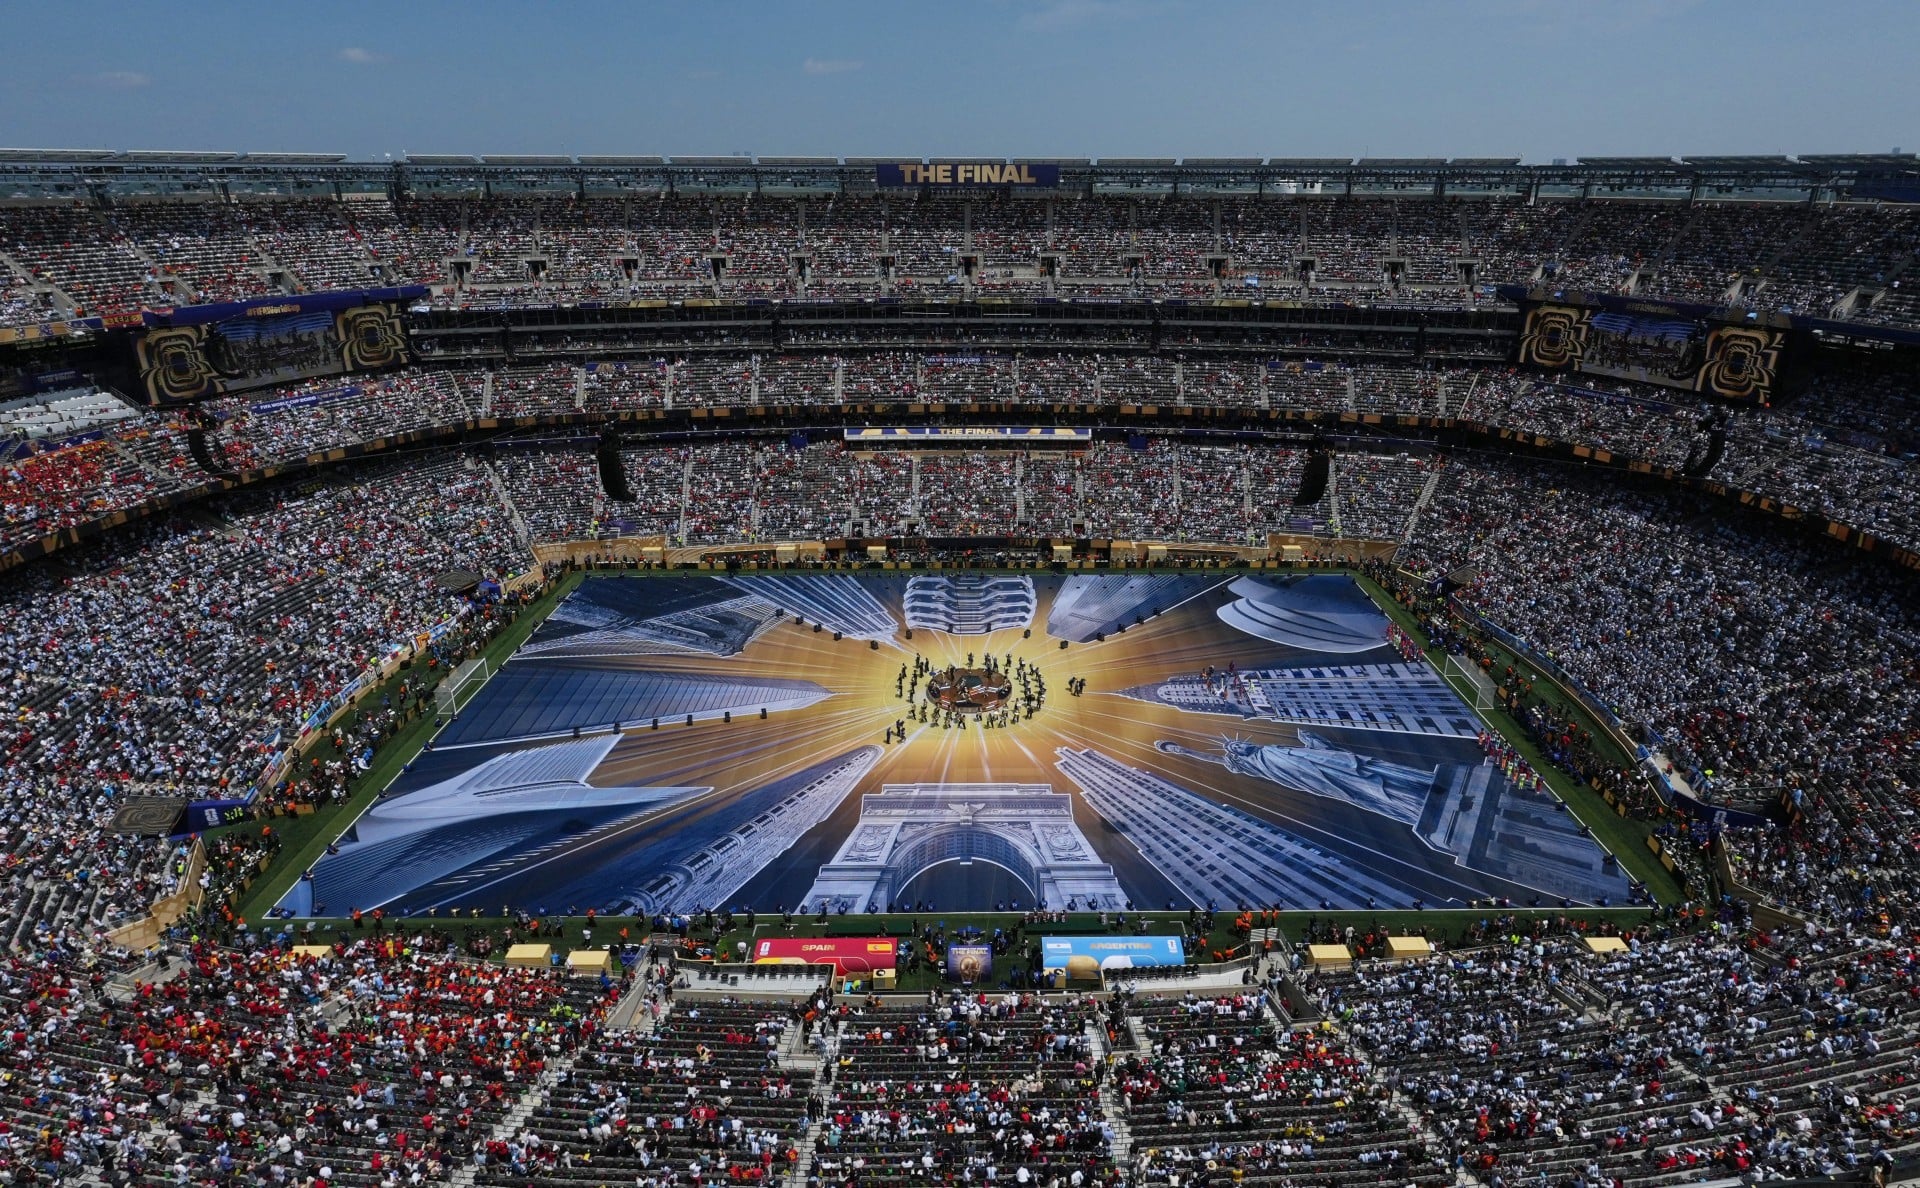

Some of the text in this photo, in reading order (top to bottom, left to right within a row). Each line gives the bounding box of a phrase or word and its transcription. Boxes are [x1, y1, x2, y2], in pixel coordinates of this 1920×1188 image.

[898, 164, 1037, 184] THE FINAL
[939, 428, 1002, 436] THE FINAL
[1703, 481, 1726, 496] FIFA
